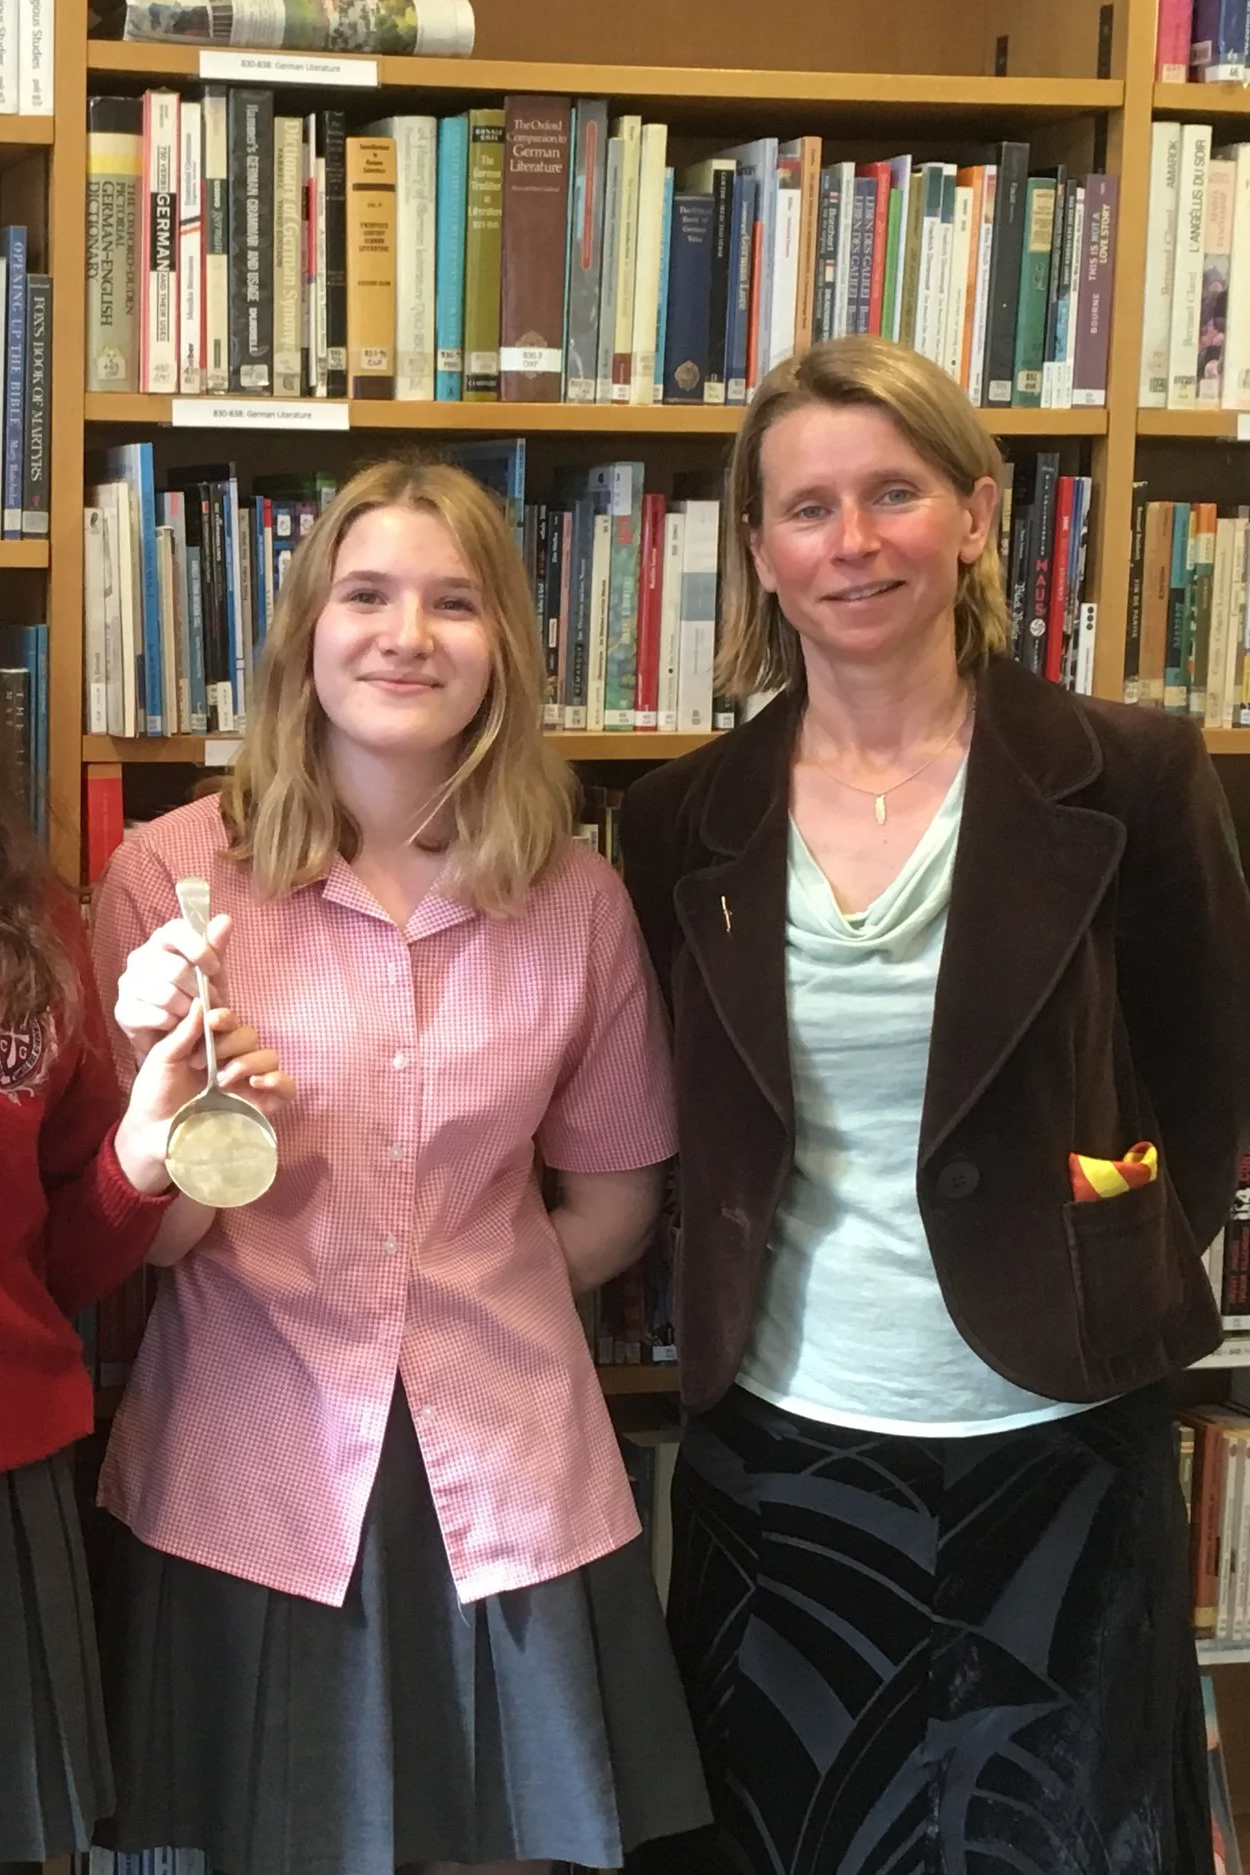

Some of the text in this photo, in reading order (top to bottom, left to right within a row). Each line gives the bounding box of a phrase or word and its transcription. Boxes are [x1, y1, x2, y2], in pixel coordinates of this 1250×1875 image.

[274, 62, 304, 72] German
[306, 63, 341, 73] Literature
[506, 133, 566, 144] Companion to
[514, 119, 562, 131] The Oxford
[282, 121, 299, 200] Dictionary
[481, 155, 494, 165] The
[512, 144, 560, 158] German
[1193, 139, 1206, 167] SOIR
[158, 163, 167, 192] VERBS
[510, 159, 562, 173] Literature
[1191, 169, 1204, 186] DU
[115, 182, 126, 248] PICTORIAL
[283, 204, 299, 220] of
[1187, 189, 1203, 253] L'ANGÉLUS
[86, 181, 101, 283] DICTIONARY
[156, 193, 170, 271] GERMAN
[211, 210, 223, 254] german
[246, 104, 259, 353] Hammer's GERMAN GRAMMAR AND USAGE DURRELL
[827, 208, 837, 252] Borchert
[1090, 221, 1100, 242] NOT
[1099, 203, 1111, 264] LOVE STORY
[100, 181, 114, 326] GERMAN-ENGLISH
[125, 183, 136, 315] THE OXFORD-DUDEN
[282, 222, 298, 285] German
[848, 196, 863, 298] LEBEN DES GALILEI
[860, 196, 875, 298] LEBEN DES GALILEI
[1089, 244, 1098, 255] IS
[10, 241, 23, 312] OPENING
[159, 273, 167, 291] AND
[1088, 258, 1098, 281] THIS
[159, 292, 167, 317] THEIR
[1089, 293, 1100, 334] BOURNE
[10, 319, 21, 338] UP
[159, 320, 167, 342] USES
[10, 344, 21, 373] THE
[30, 296, 46, 481] FOX'S BOOK OF MARTYRS
[9, 382, 21, 427] BIBLE
[246, 410, 274, 419] German
[276, 411, 312, 420] Literature
[1132, 596, 1139, 607] DE
